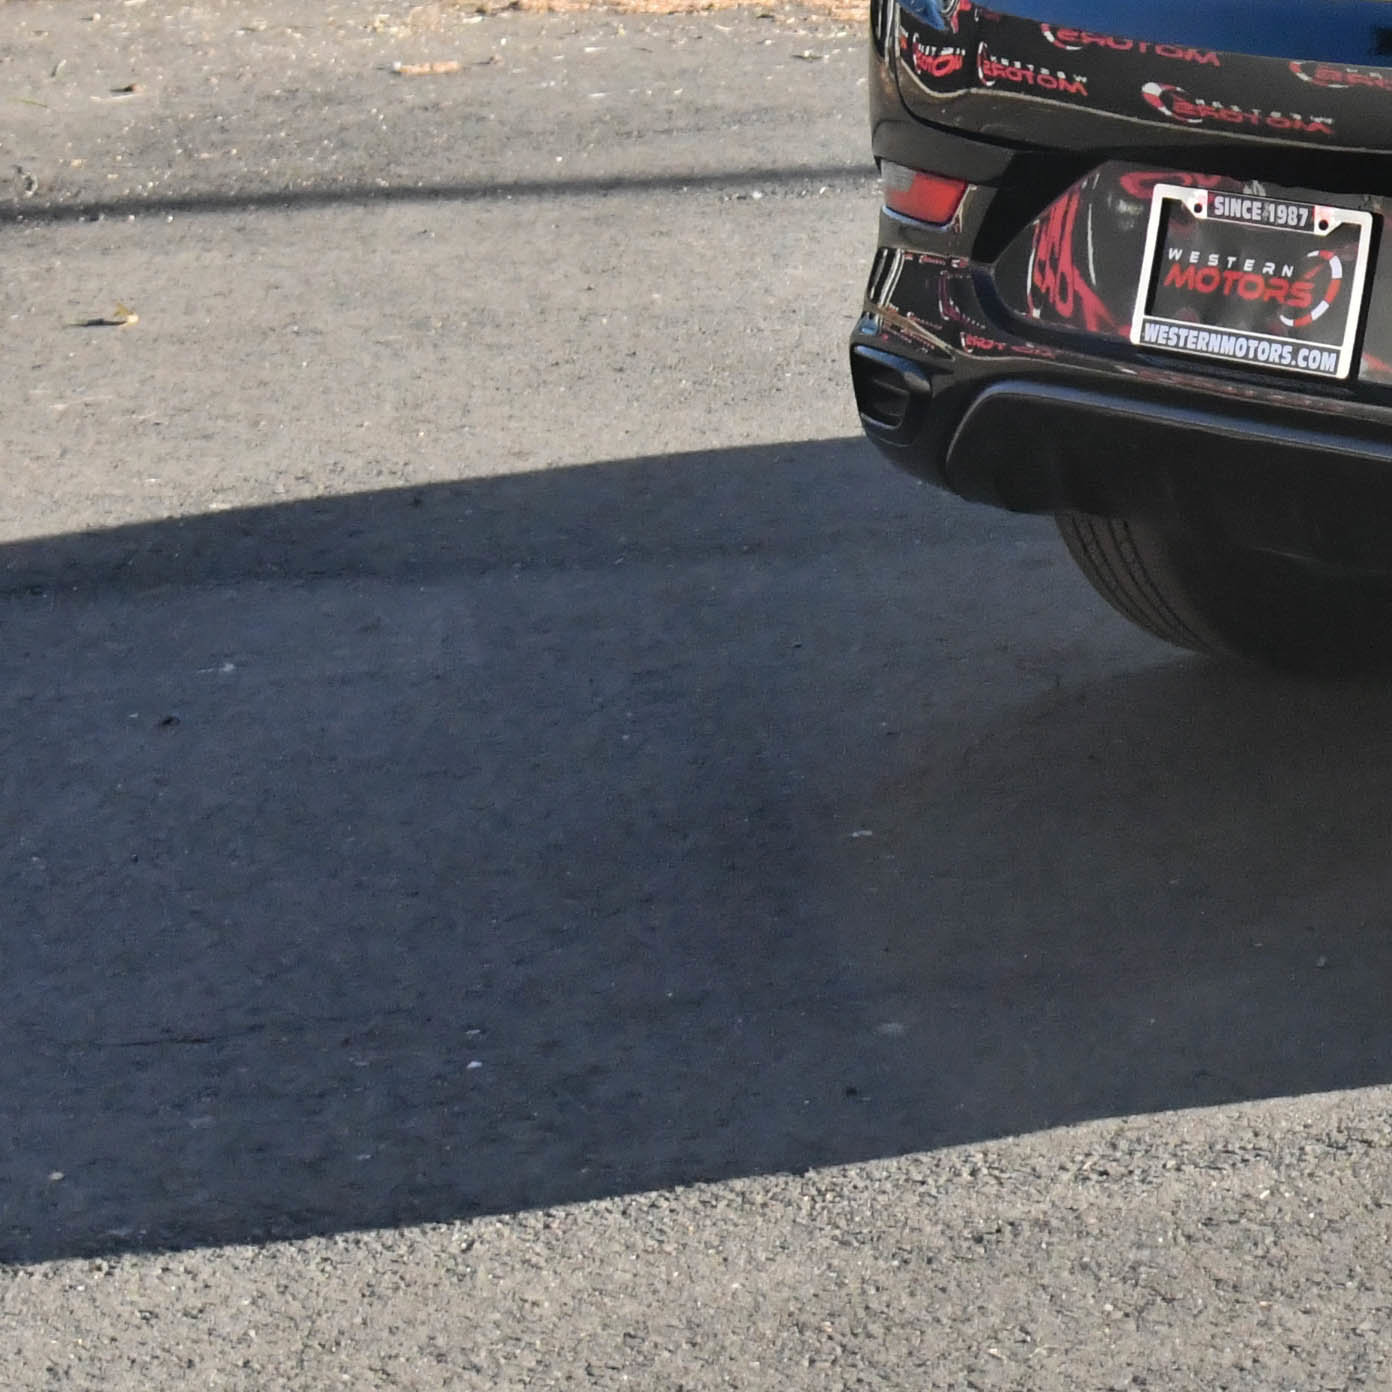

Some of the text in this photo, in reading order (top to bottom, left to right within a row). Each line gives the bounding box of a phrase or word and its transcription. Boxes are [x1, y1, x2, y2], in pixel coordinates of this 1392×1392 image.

[1213, 195, 1310, 227] SINCE 1987
[1168, 247, 1295, 279] WESTERN
[1163, 262, 1316, 309] MOTORS
[1143, 322, 1338, 373] WESTERNMOTORS.COM
